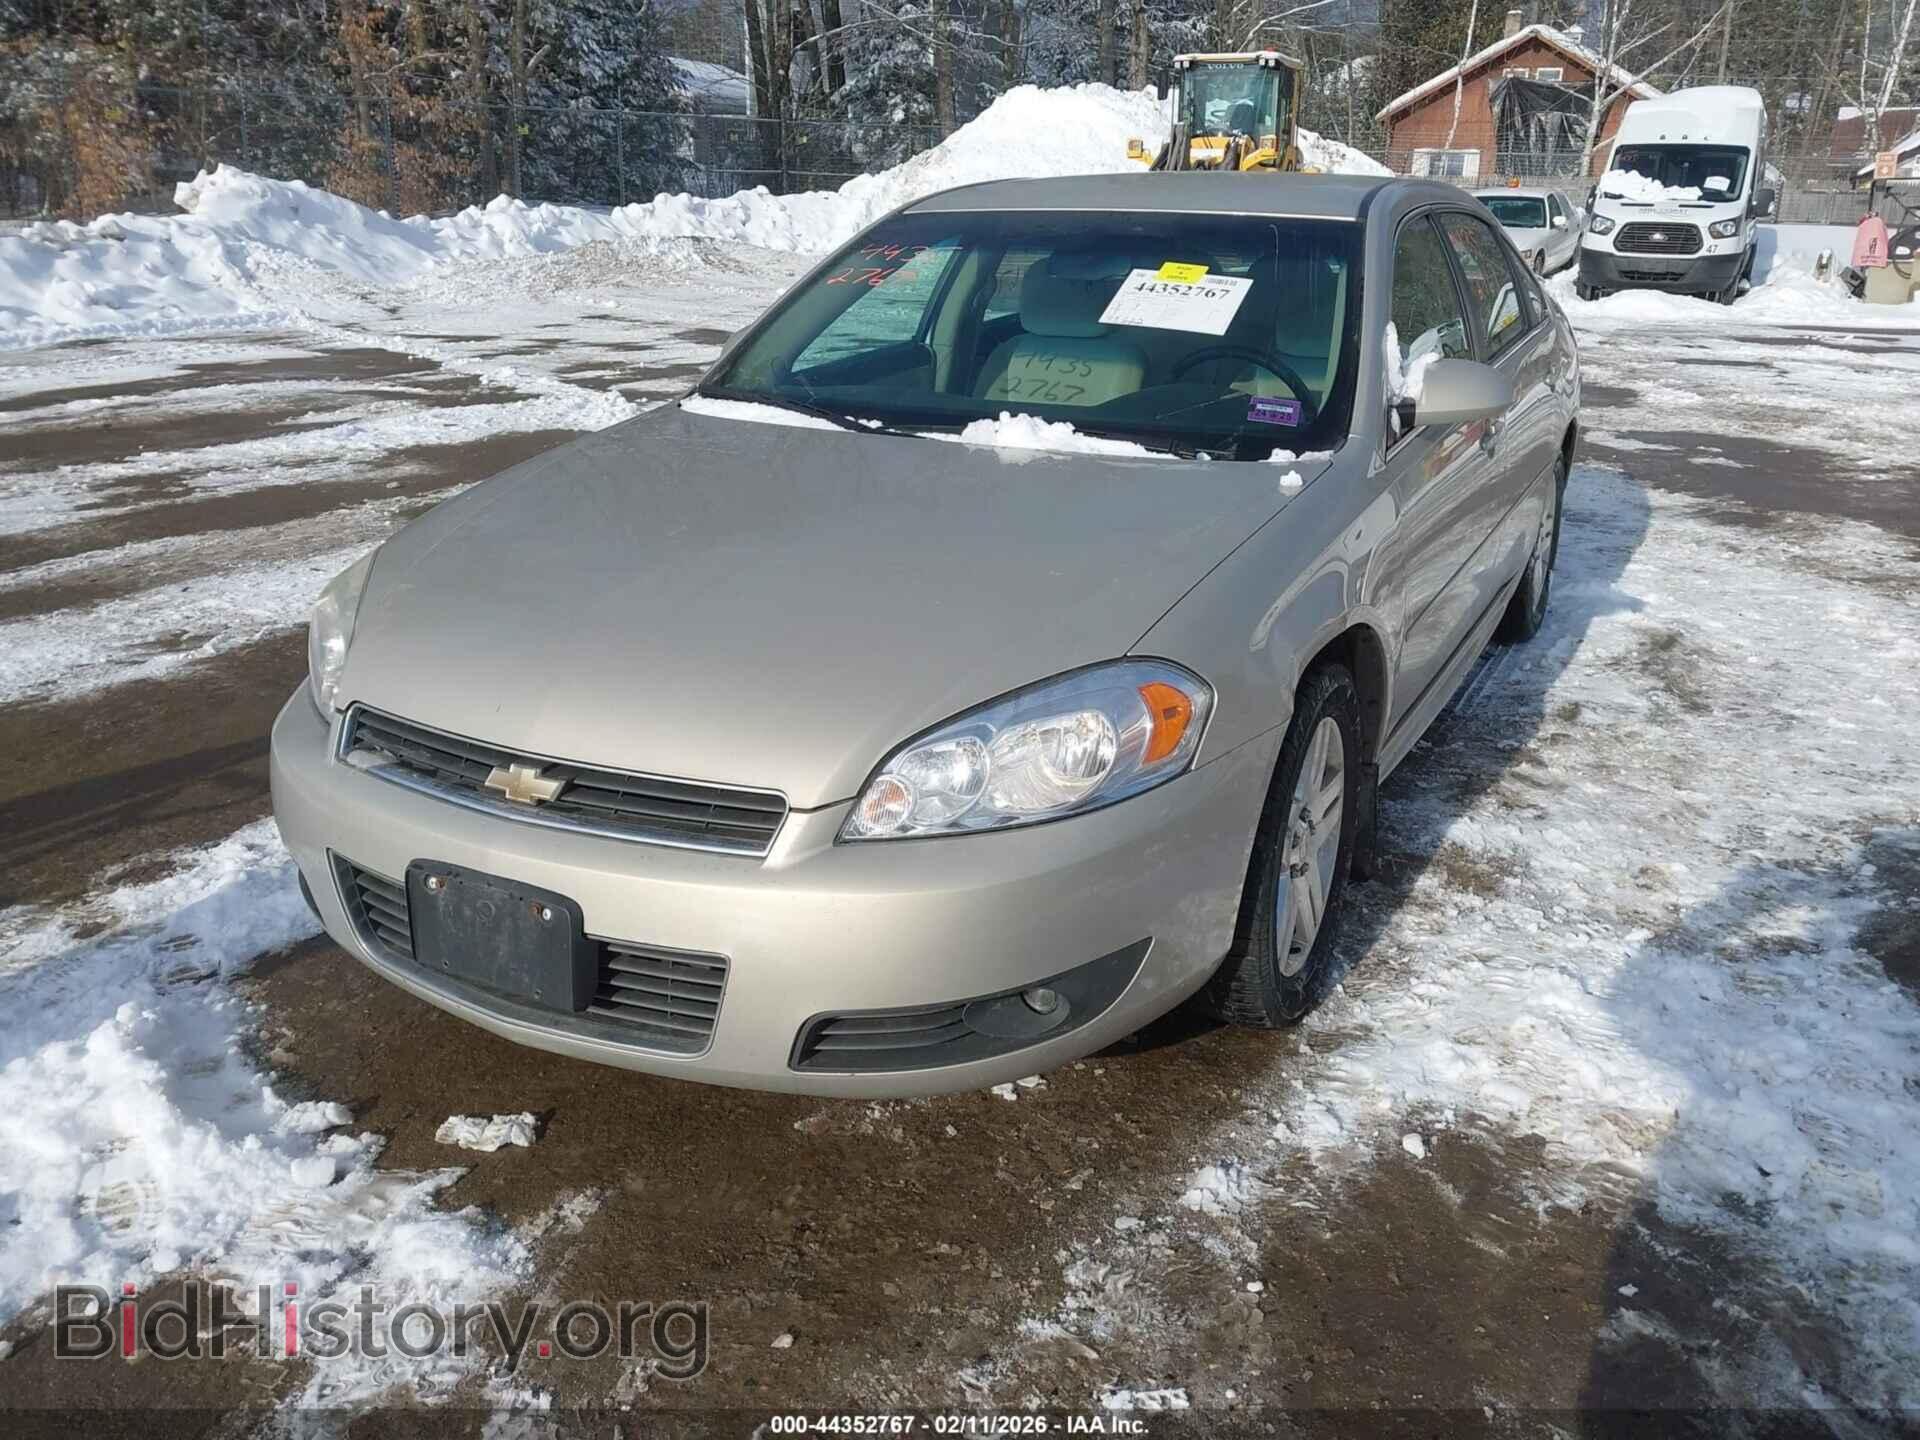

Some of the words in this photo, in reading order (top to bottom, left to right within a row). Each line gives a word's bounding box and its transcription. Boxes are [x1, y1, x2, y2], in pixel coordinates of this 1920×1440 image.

[1706, 244, 1719, 254] 47
[1133, 282, 1231, 300] 44352767
[997, 376, 1086, 402] 2767
